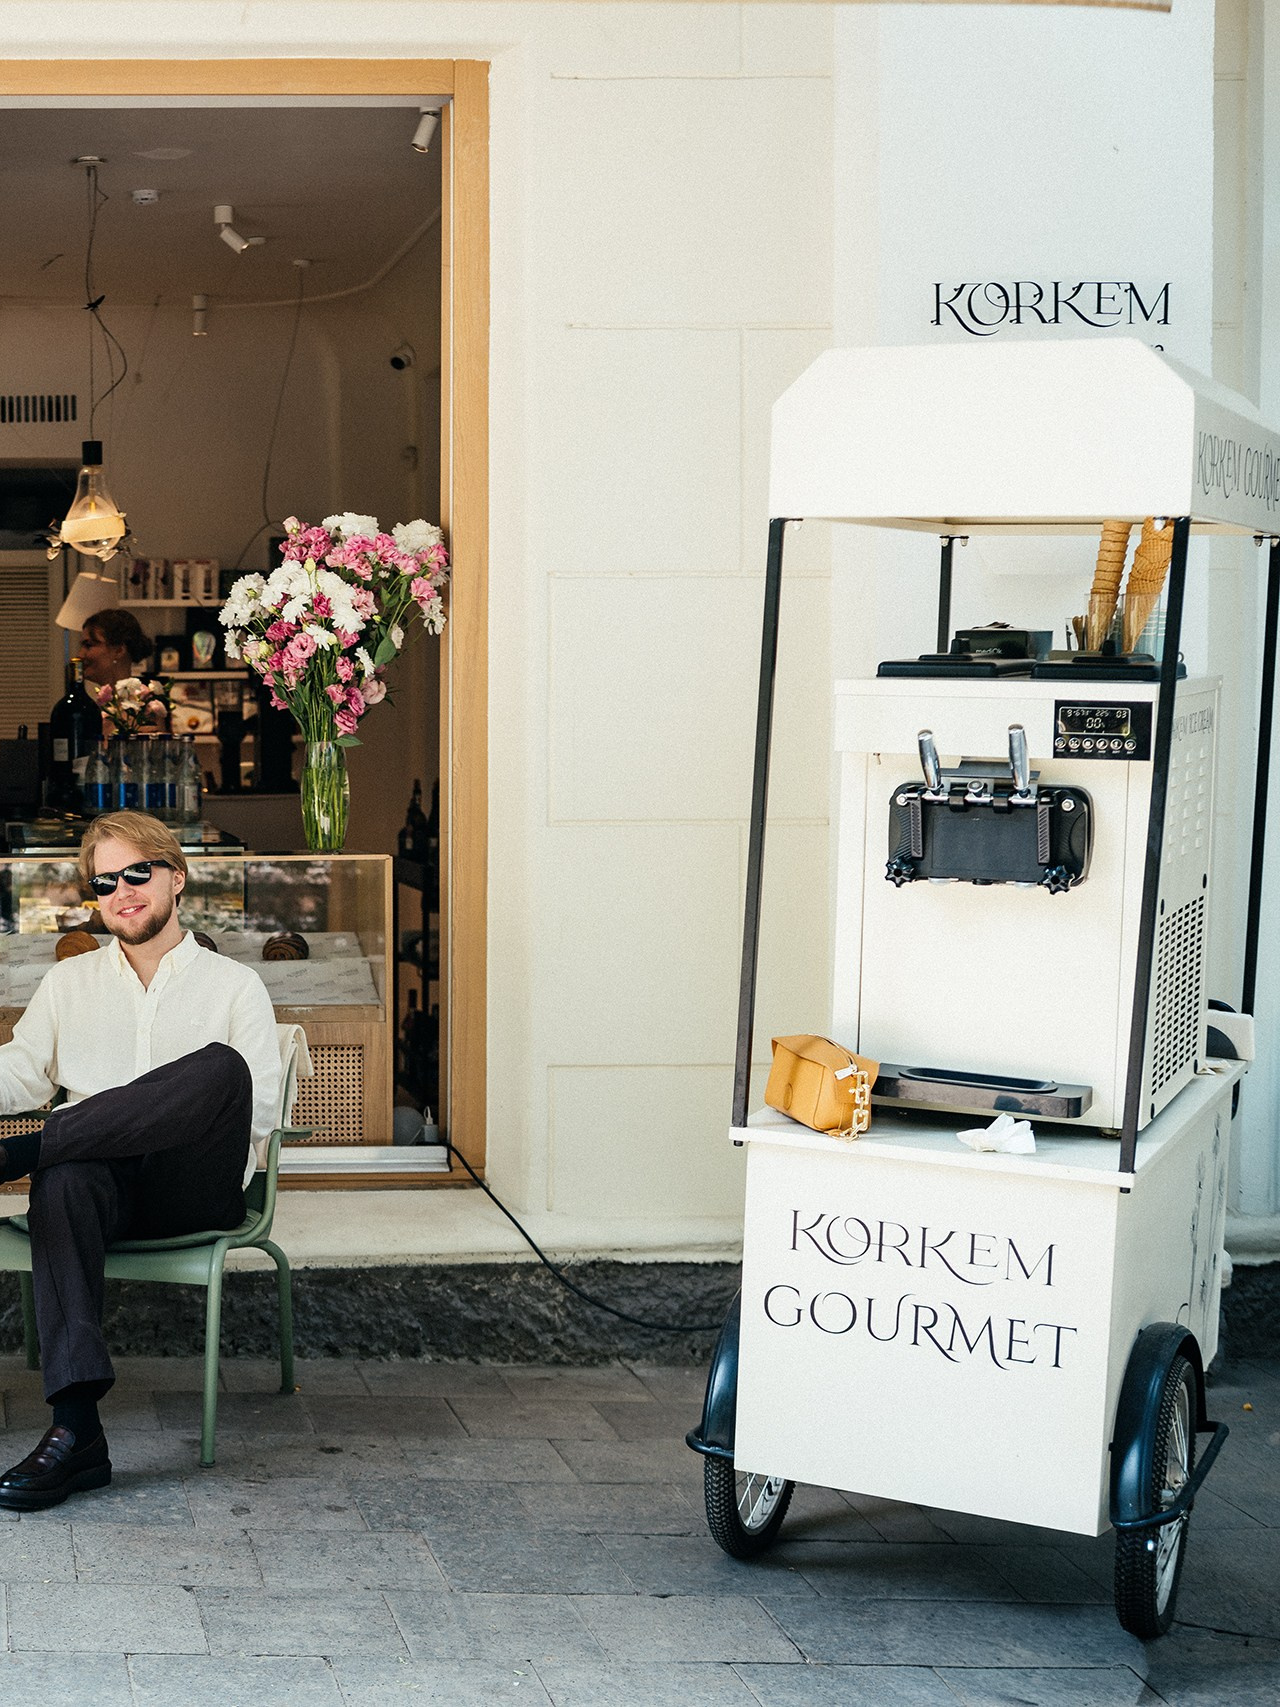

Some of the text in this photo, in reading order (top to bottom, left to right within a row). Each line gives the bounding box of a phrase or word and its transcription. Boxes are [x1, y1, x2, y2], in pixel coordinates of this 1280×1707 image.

[930, 281, 1173, 337] KORKEM
[1197, 431, 1280, 512] KORKEM GOURME
[789, 1208, 1059, 1287] KORKEM
[763, 1283, 1078, 1371] GOURMET
